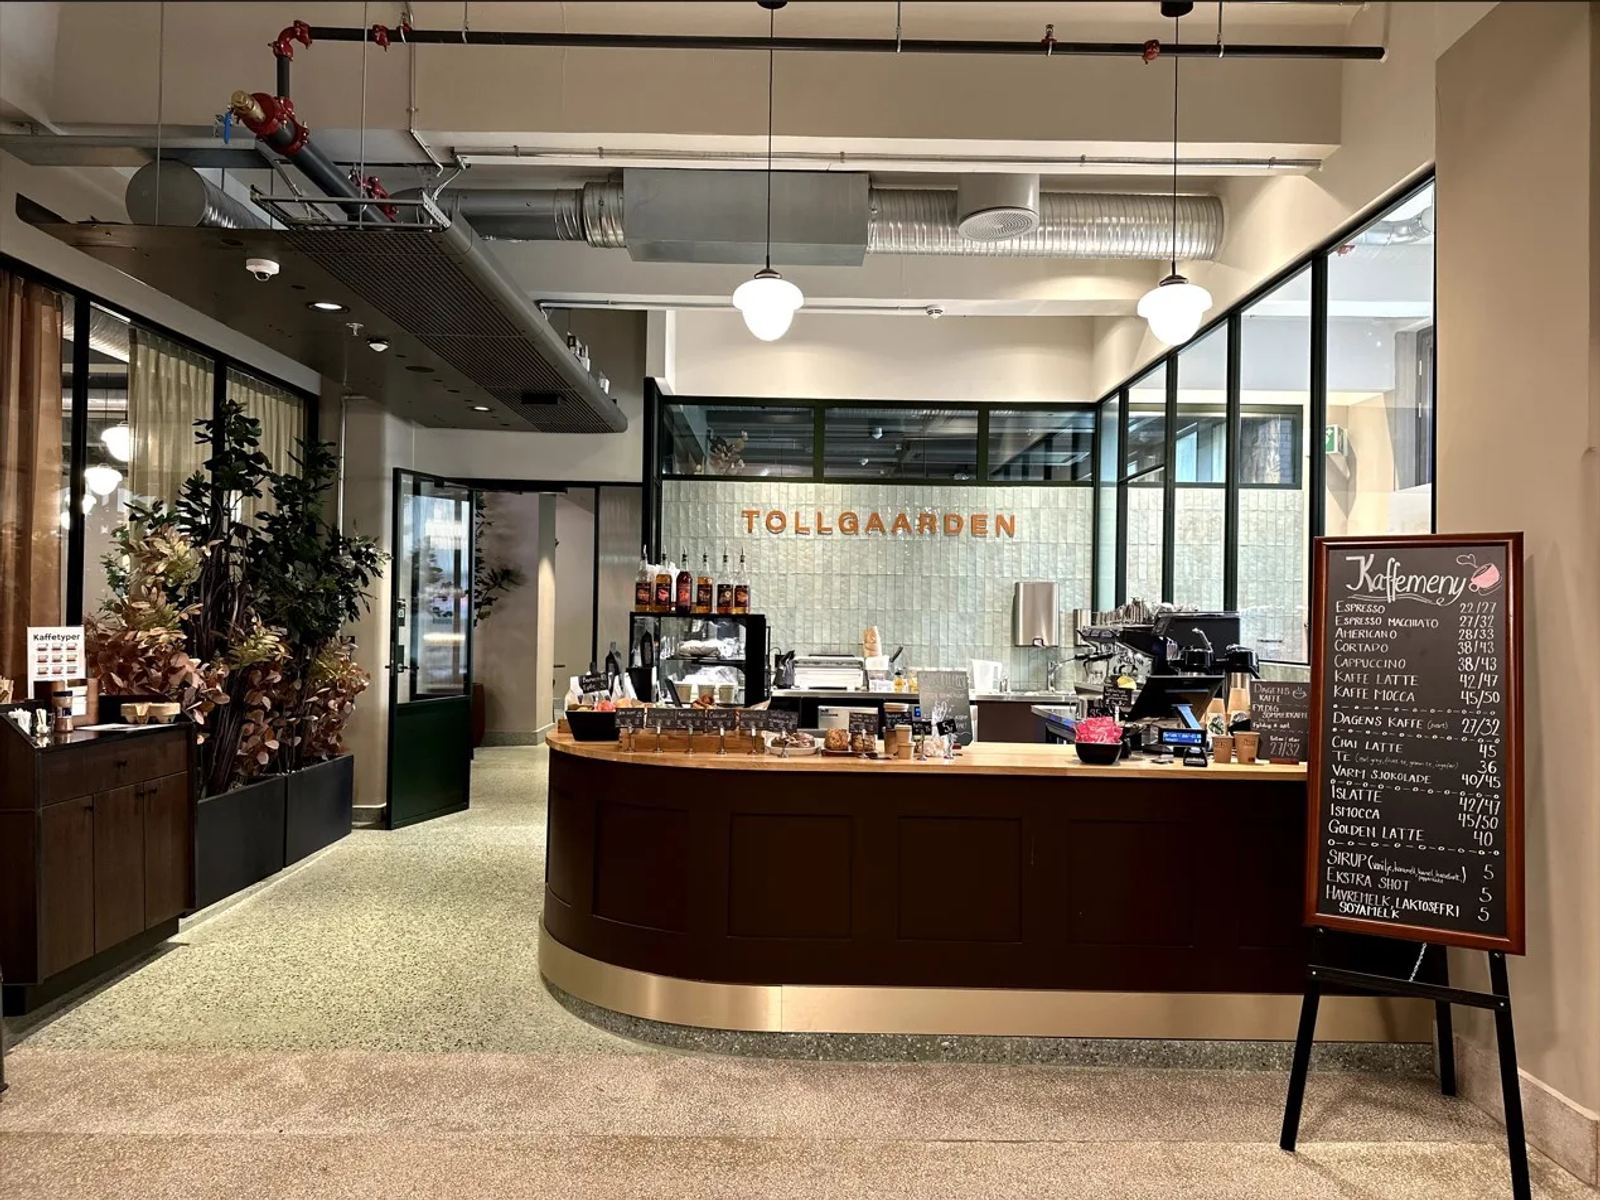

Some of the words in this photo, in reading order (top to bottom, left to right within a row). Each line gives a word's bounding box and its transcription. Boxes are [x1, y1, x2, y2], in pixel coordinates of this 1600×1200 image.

[741, 510, 1016, 538] TOLLGAARDEN
[1345, 553, 1467, 604] Kaffemeny
[1336, 601, 1386, 614] ESPRESSO
[1459, 601, 1497, 614] 22/27
[1335, 615, 1382, 626] ESPRESSO
[1387, 617, 1439, 628] MACCHIATO
[1459, 614, 1495, 629] 27/32
[33, 633, 80, 641] Kaffetyper
[1335, 627, 1397, 640] AMERICANO
[1458, 628, 1495, 641] 28/33
[1334, 639, 1389, 653] CORTADO
[1457, 640, 1495, 655] 38/43
[1334, 655, 1406, 669] CAPPUCCINO
[1457, 656, 1497, 672] 38/43
[1254, 683, 1291, 695] DAGENS
[1334, 669, 1369, 685] KAFFE
[1376, 674, 1418, 687] LATTE
[1459, 672, 1499, 690] 42/47
[1333, 684, 1369, 699] KAFFE
[1374, 689, 1415, 702] MOCCA
[1460, 690, 1500, 709] 45/50
[1333, 711, 1382, 726] DAGENS
[1388, 717, 1423, 729] KAFFE
[1461, 717, 1500, 737] 27/32
[1332, 735, 1357, 749] CHAI
[1365, 741, 1403, 753] LATTE
[1479, 744, 1497, 759] 45
[1332, 750, 1351, 762] TE
[1477, 760, 1497, 774] 36
[1332, 764, 1366, 779] VARM
[1370, 769, 1432, 784] SJOKOLADE
[1461, 773, 1501, 788] 40/45
[1331, 784, 1382, 803] ISLATTE
[1459, 797, 1500, 815] 42/47
[1331, 803, 1380, 819] ISMOCCA
[1458, 813, 1499, 829] 45/50
[1328, 819, 1376, 838] GOLDEN
[1382, 826, 1425, 841] LATTE
[1473, 831, 1493, 846] 40
[1483, 864, 1494, 880] 5
[1326, 867, 1372, 887] EKSTRA
[1378, 877, 1408, 891] SHOT
[1479, 887, 1492, 902] 5
[1339, 902, 1400, 919] SOYAMELK
[1395, 898, 1460, 917] LAKTOSEFRI
[1477, 906, 1490, 922] 5
